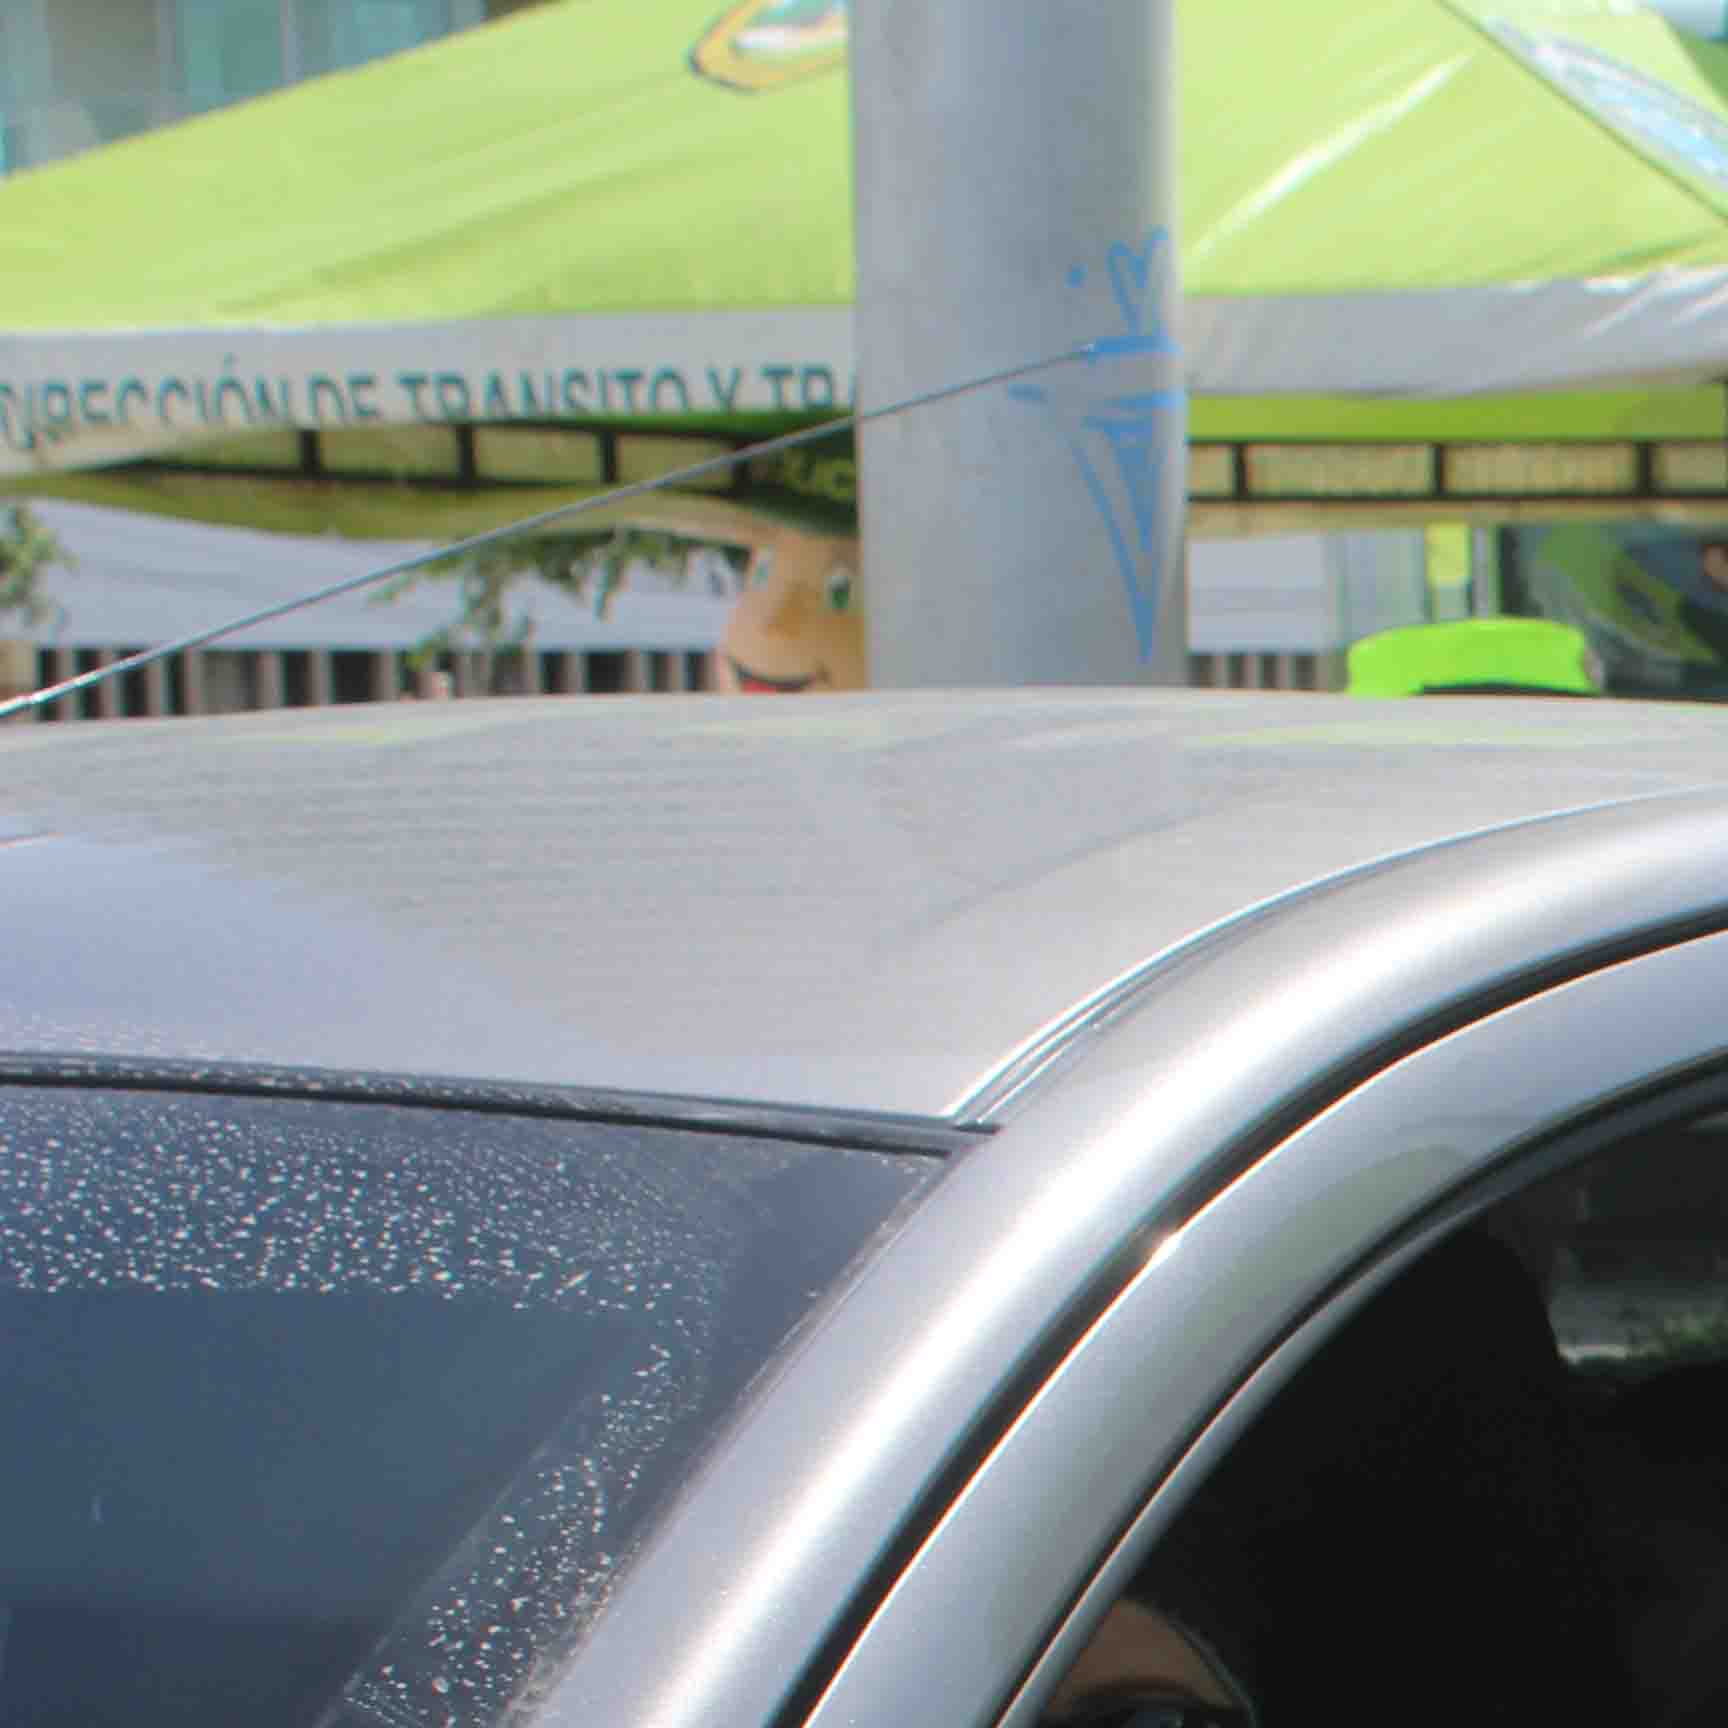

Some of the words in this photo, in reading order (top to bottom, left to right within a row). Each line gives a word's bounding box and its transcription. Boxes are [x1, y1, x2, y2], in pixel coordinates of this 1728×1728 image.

[305, 369, 379, 422] DE
[395, 366, 690, 422] TRANSITO
[706, 364, 741, 413] Y
[760, 362, 856, 412] TR
